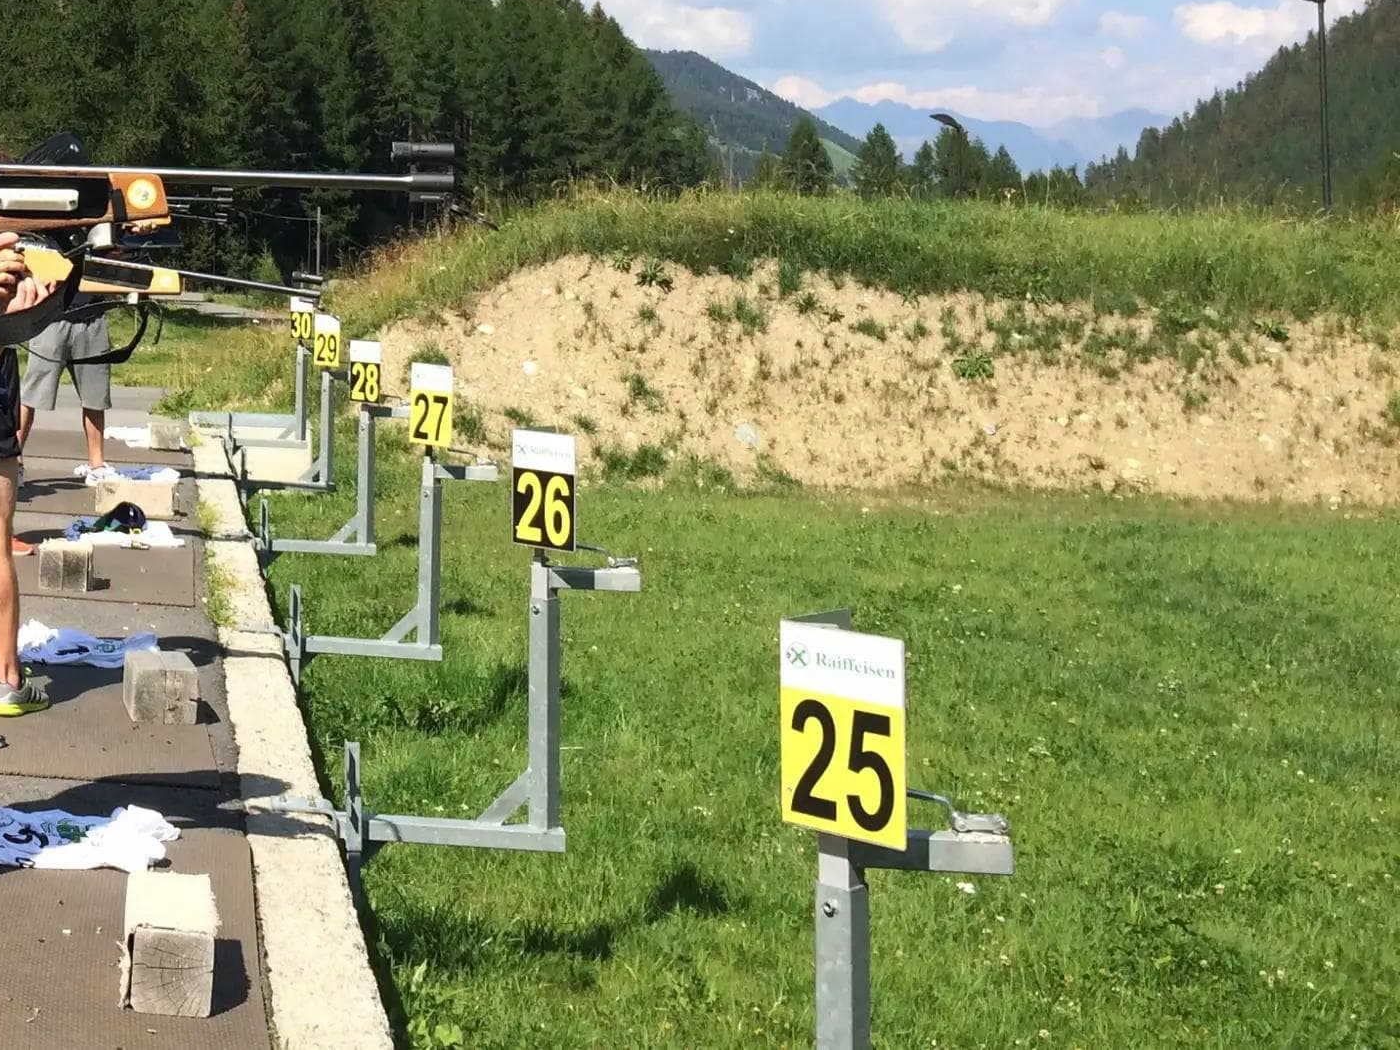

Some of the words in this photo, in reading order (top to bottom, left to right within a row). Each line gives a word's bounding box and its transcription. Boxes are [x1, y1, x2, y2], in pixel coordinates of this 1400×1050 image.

[291, 312, 312, 339] 30
[316, 333, 337, 363] 29
[351, 362, 379, 402] 28
[413, 393, 449, 442] 27
[515, 471, 570, 546] 26
[816, 651, 896, 679] Raiffeisen
[791, 699, 895, 832] 25
